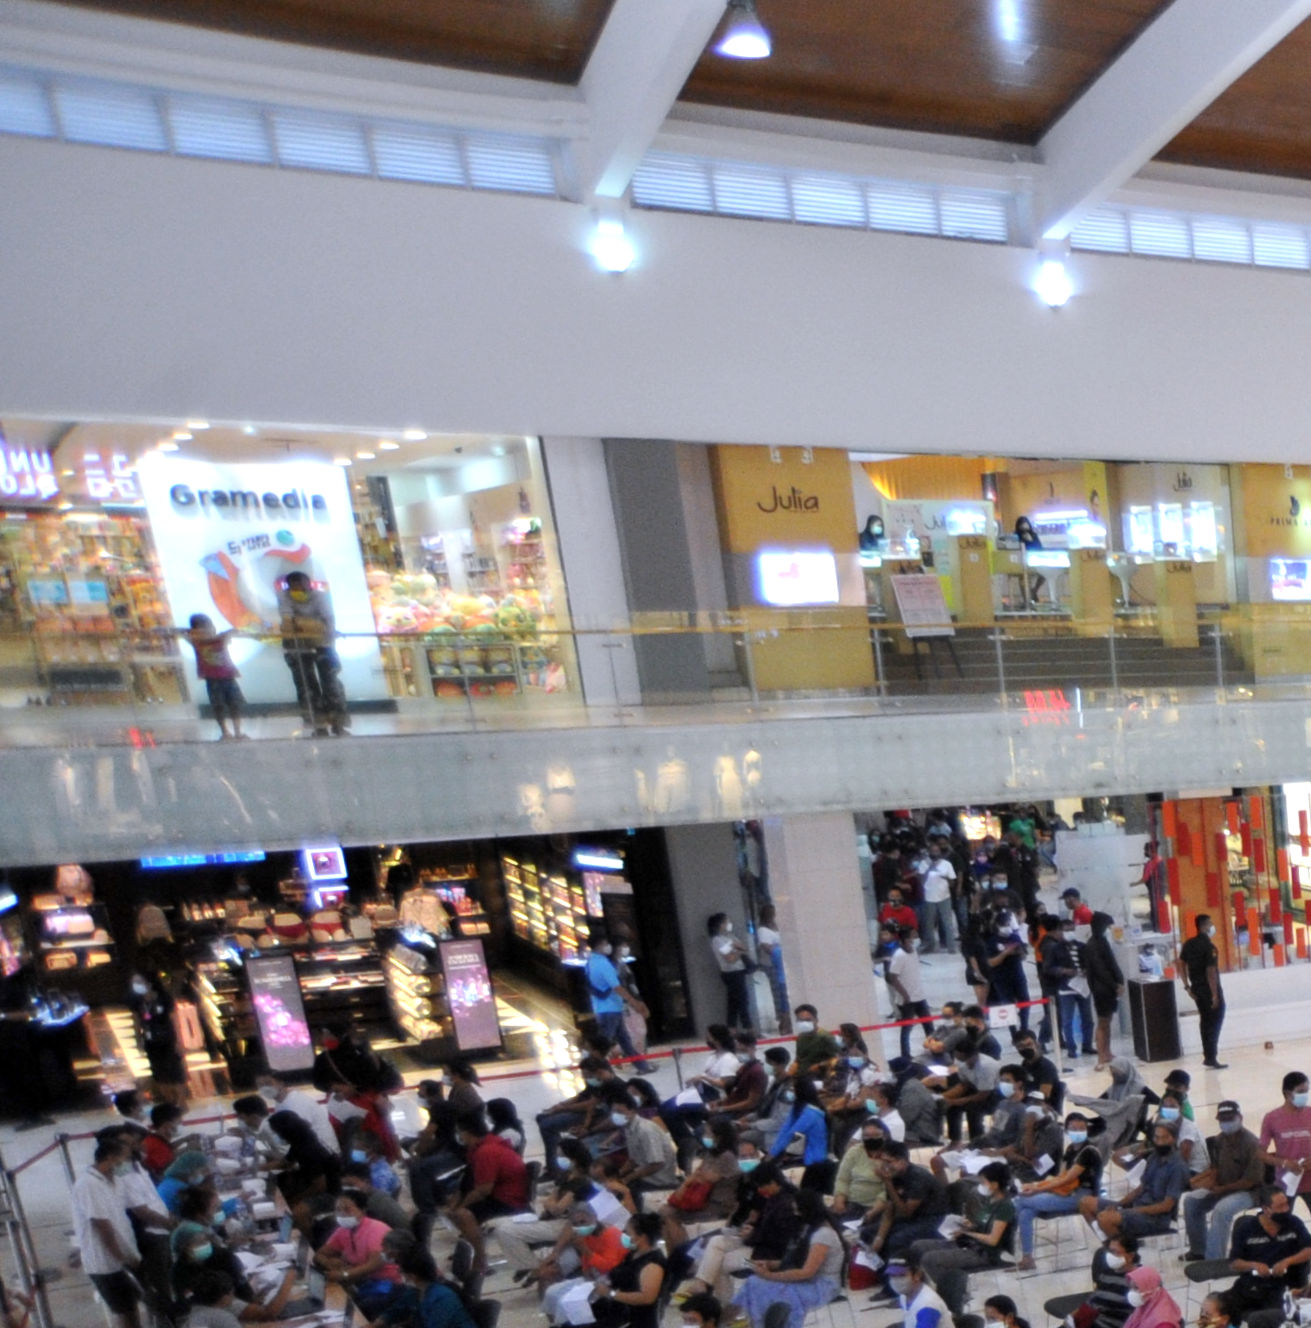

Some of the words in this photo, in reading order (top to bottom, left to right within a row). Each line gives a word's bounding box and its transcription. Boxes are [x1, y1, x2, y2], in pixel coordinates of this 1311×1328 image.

[170, 483, 328, 511] Gramedia
[756, 485, 820, 513] Julia
[1269, 517, 1299, 527] PRIMA
